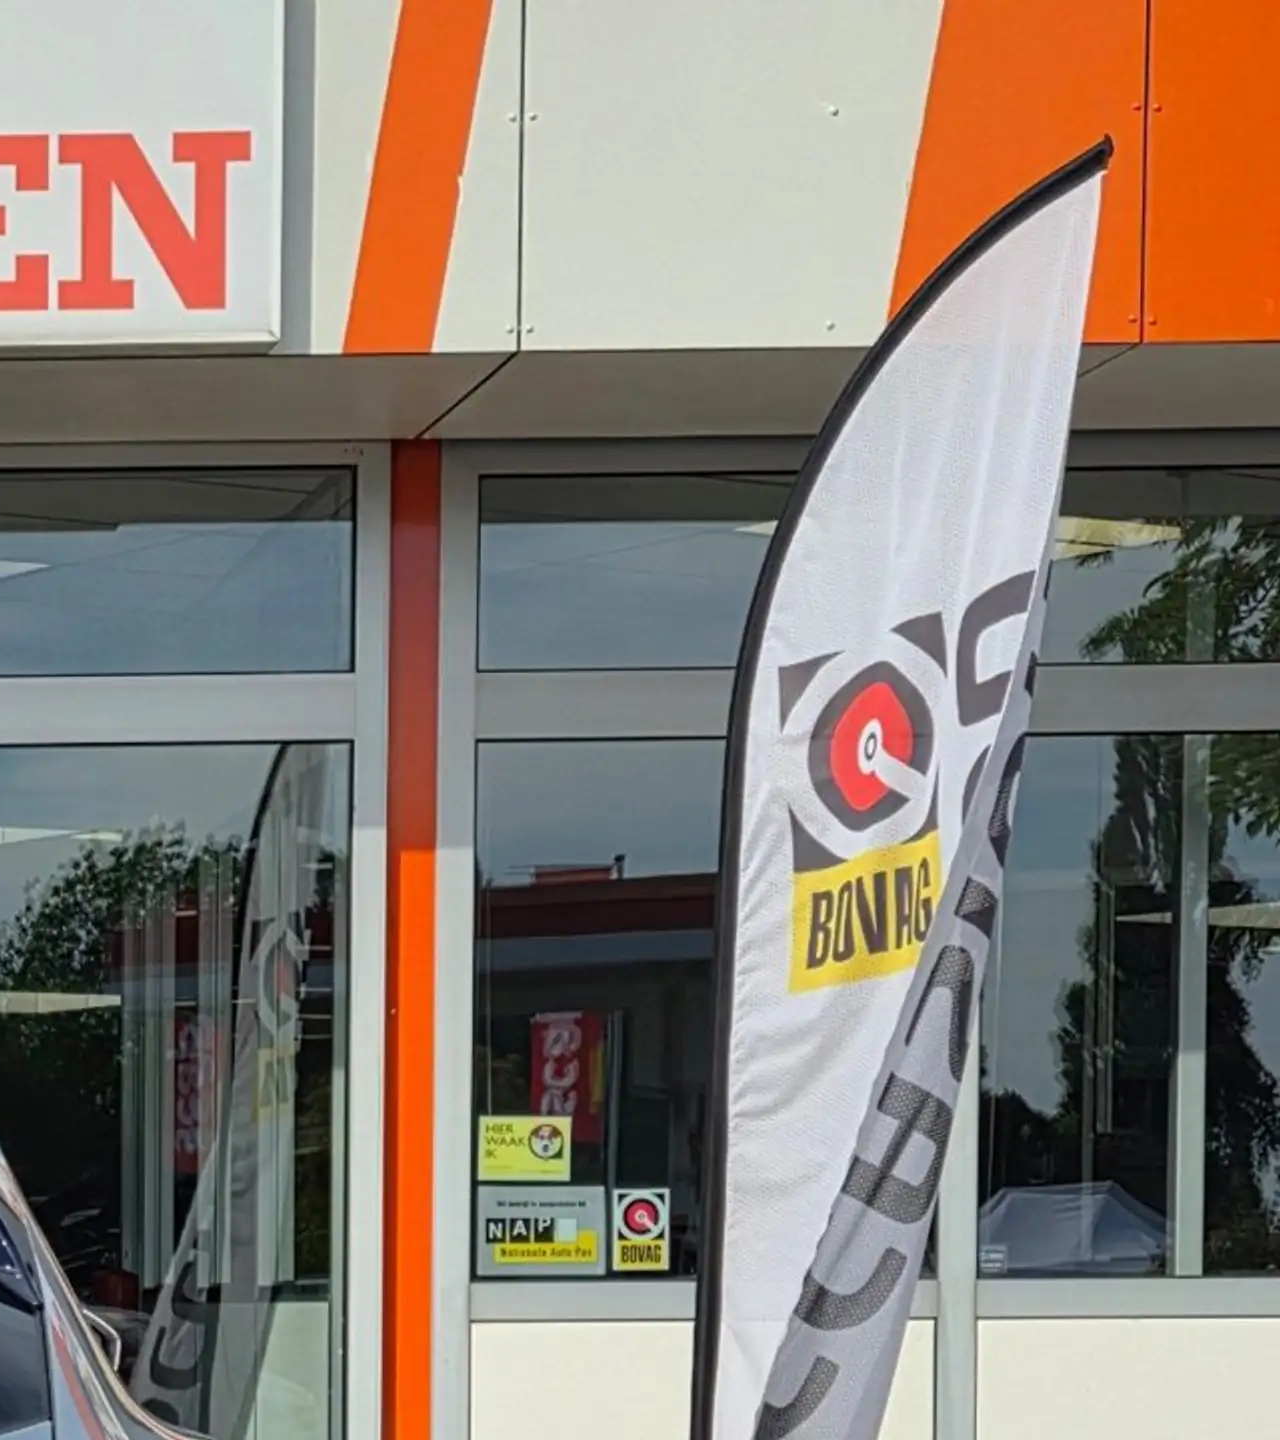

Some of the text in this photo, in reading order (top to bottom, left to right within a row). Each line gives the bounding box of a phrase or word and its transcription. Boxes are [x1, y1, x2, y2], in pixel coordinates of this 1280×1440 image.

[806, 857, 933, 971] BOVAG
[488, 1217, 551, 1240] NAP
[621, 1243, 661, 1263] BOVAG
